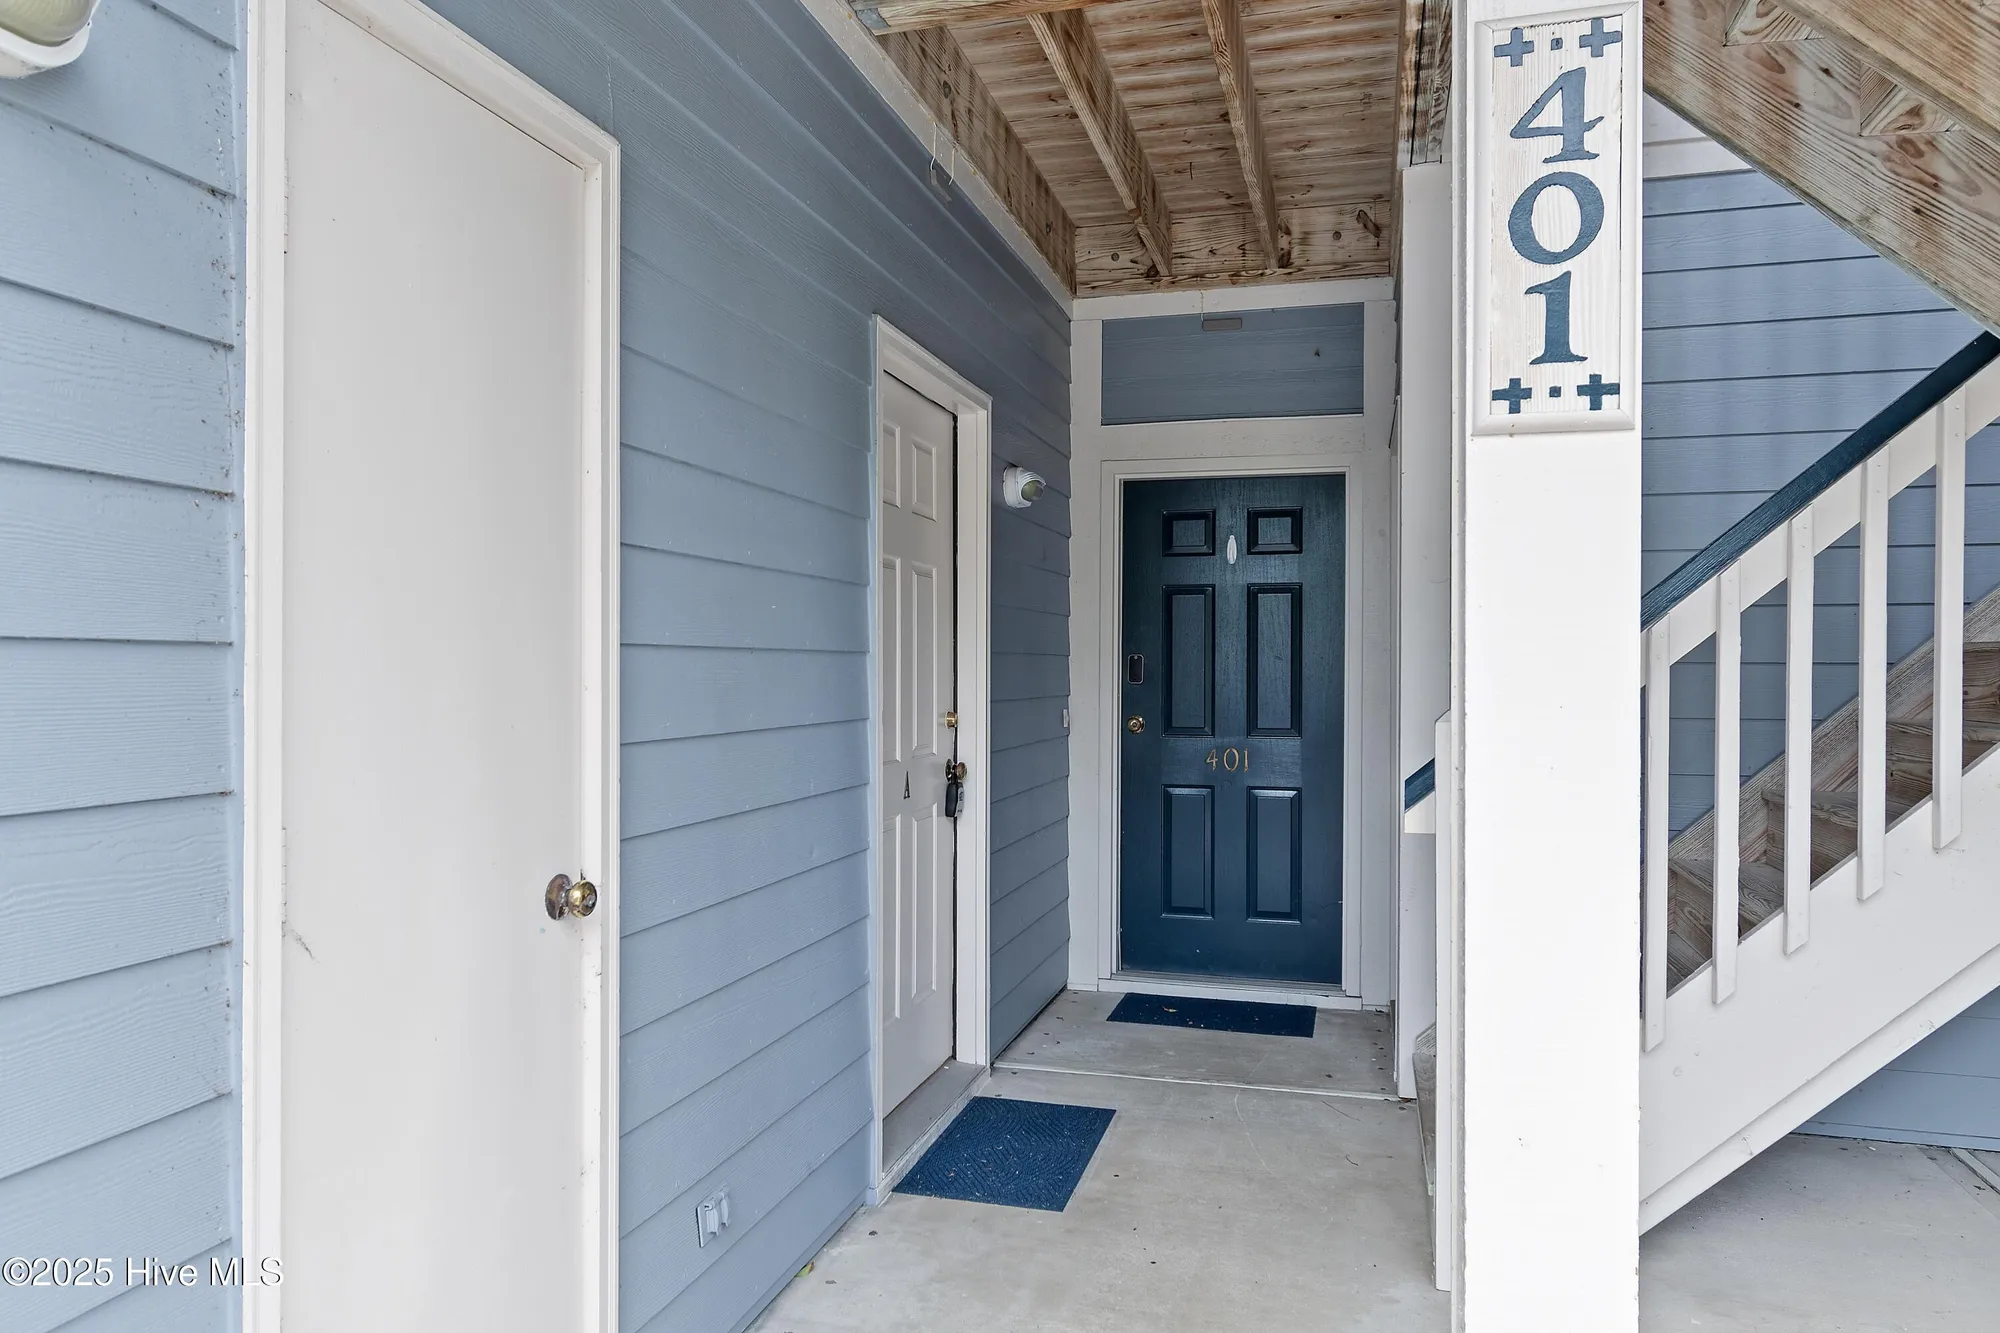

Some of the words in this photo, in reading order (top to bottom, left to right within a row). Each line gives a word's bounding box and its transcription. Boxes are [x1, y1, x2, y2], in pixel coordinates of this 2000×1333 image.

[1508, 66, 1605, 366] 401
[1205, 747, 1249, 772] 401
[903, 770, 911, 800] A
